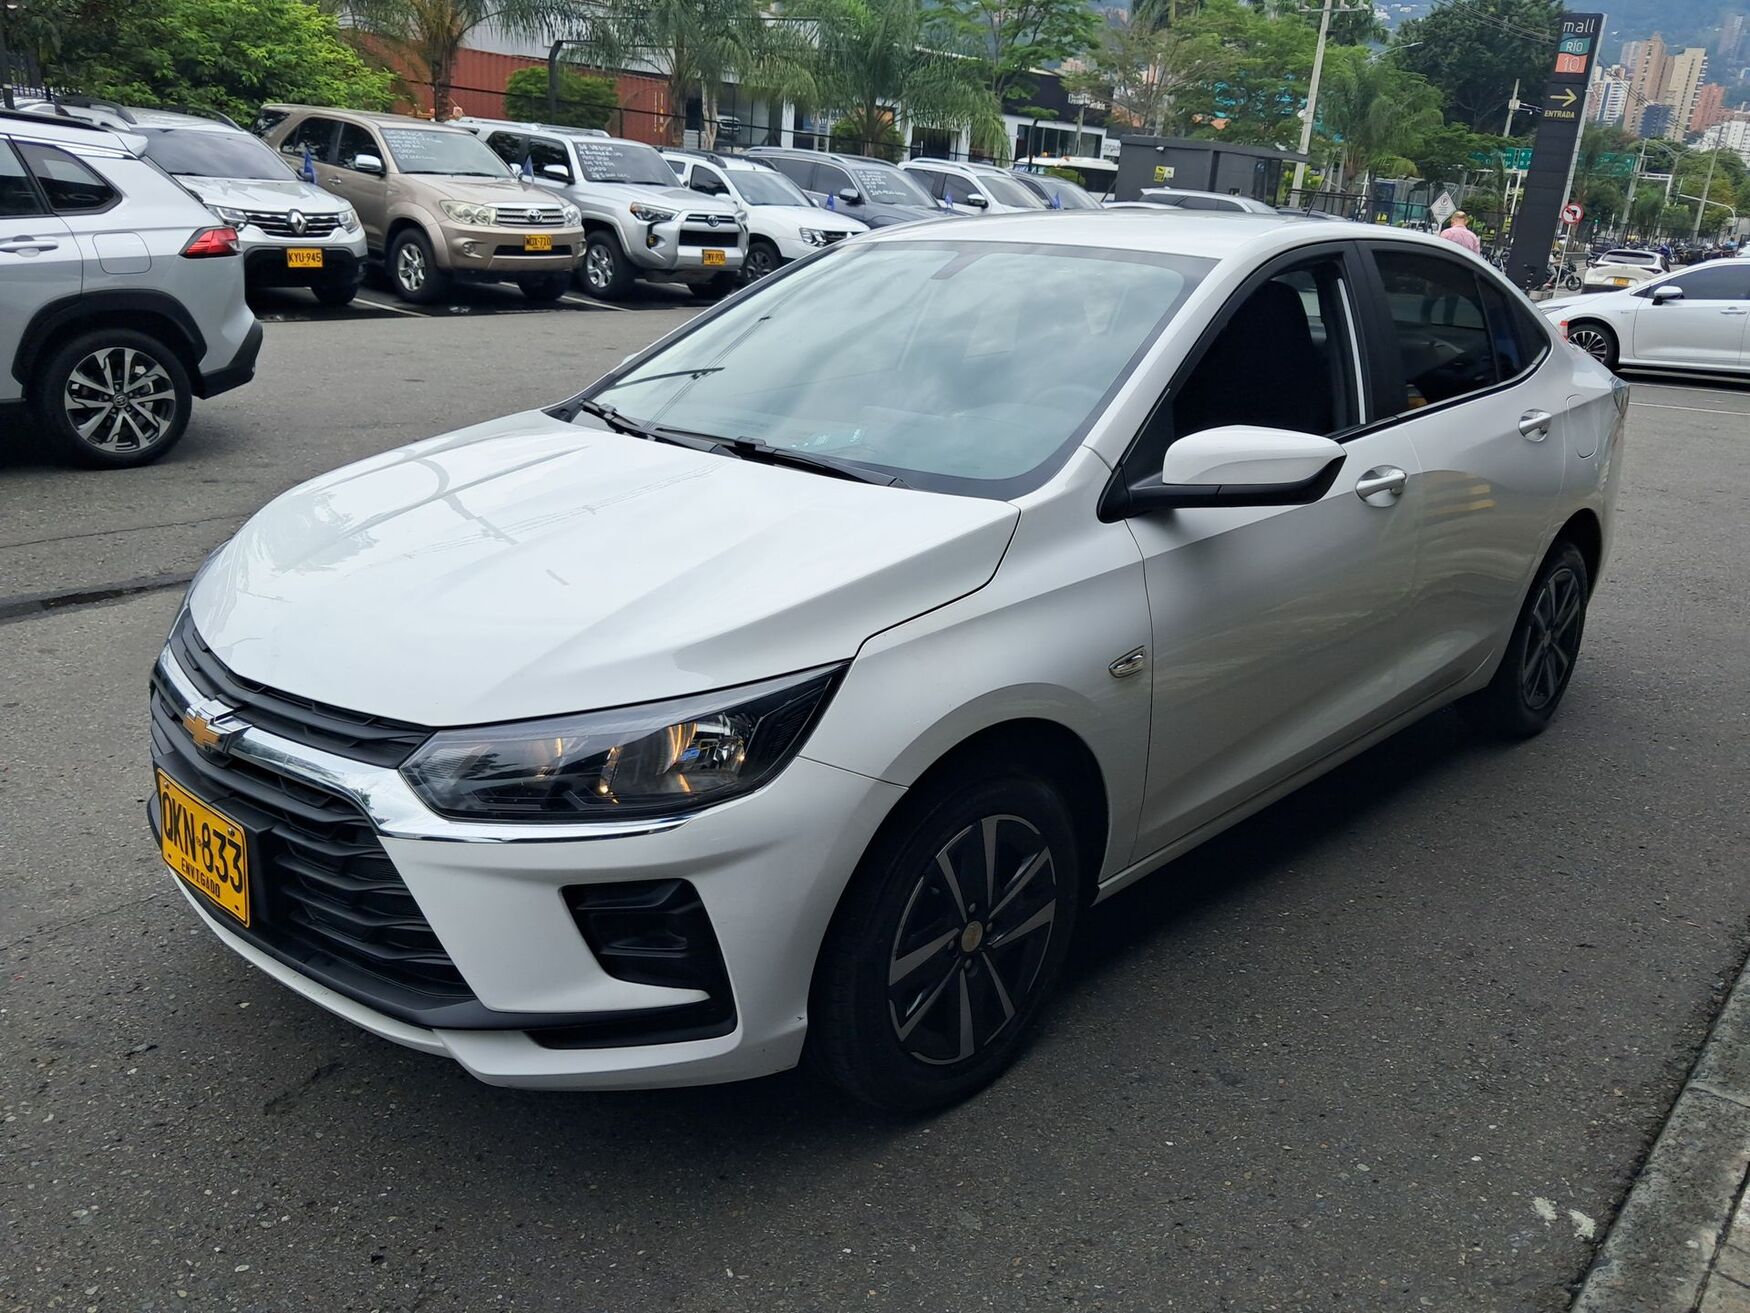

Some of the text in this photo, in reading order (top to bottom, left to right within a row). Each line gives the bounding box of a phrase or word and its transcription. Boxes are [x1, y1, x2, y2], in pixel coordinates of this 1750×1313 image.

[1562, 18, 1595, 33] mall
[1563, 56, 1581, 72] 10
[1544, 109, 1575, 119] ENTRADA
[288, 252, 321, 263] KYU-945
[181, 857, 221, 898] ENVIGADO
